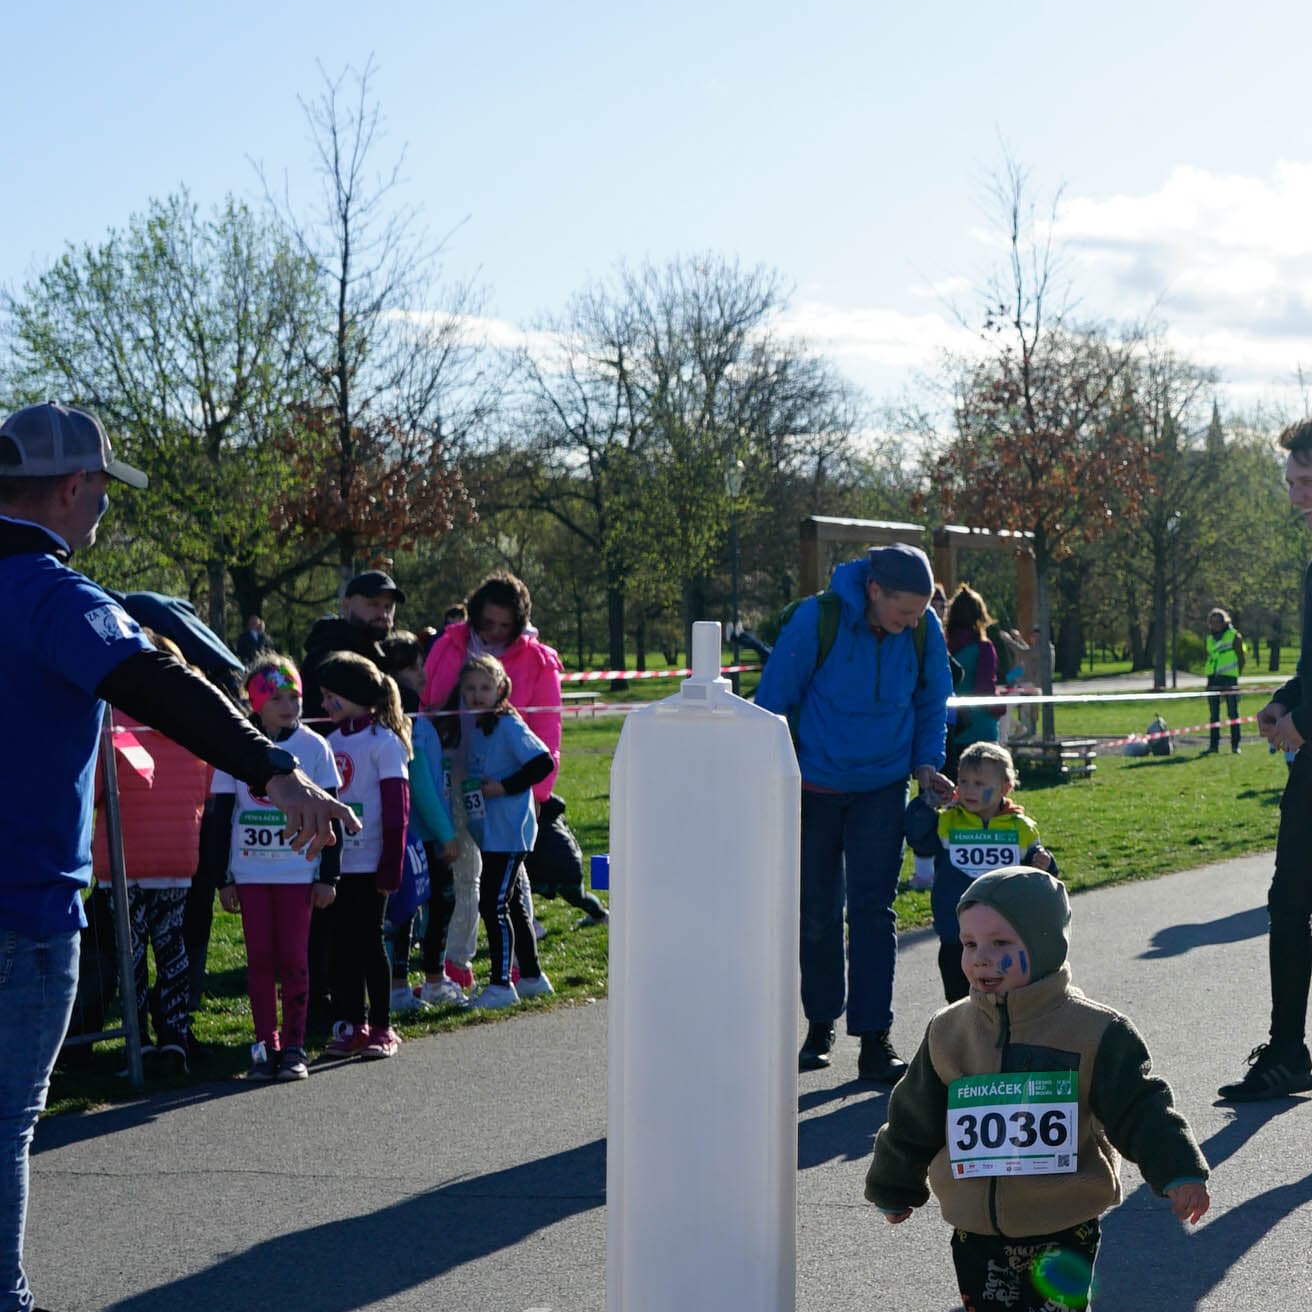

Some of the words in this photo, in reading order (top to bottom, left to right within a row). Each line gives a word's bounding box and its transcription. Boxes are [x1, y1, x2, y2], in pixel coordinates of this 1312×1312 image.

[464, 794, 481, 809] 53
[244, 828, 298, 846] 301
[955, 848, 1014, 865] 3059
[957, 1081, 1022, 1099] FÉNIXÁČEK
[956, 1110, 1067, 1151] 3036
